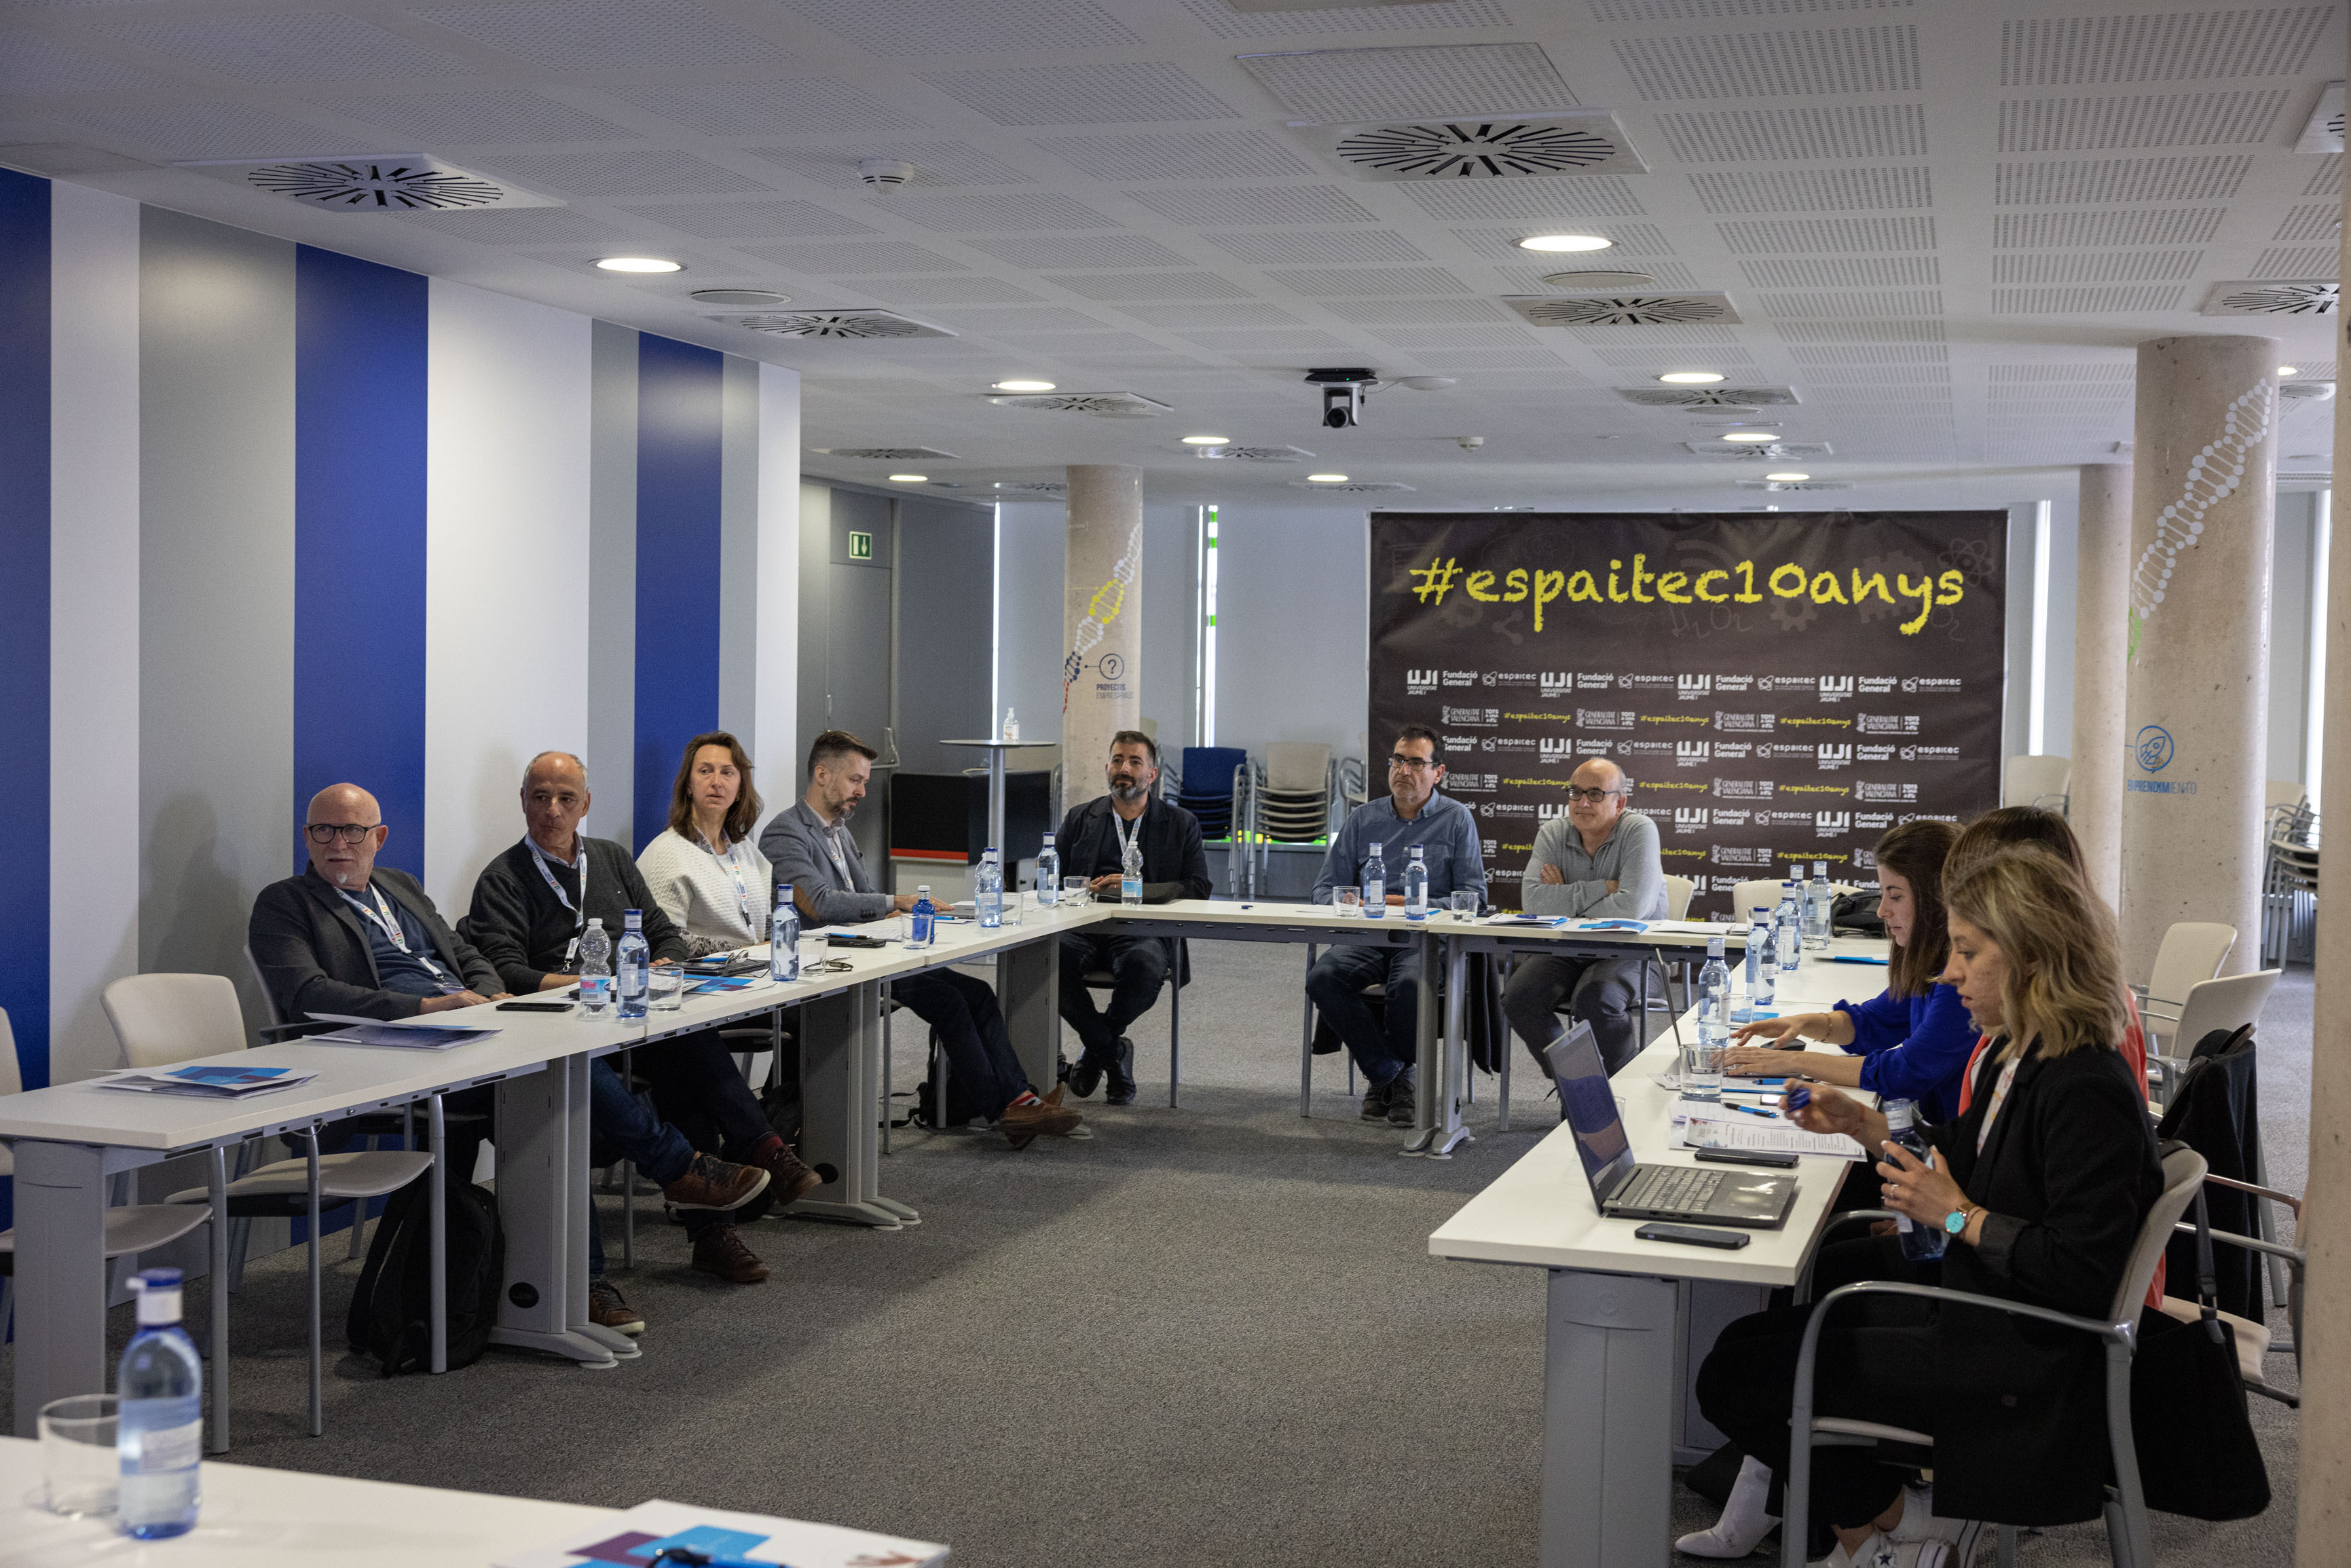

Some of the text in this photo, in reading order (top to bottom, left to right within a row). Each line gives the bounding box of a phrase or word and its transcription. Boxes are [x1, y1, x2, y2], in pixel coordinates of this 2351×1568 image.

[1409, 554, 1964, 635] #espaitec10anys
[1407, 670, 1438, 684] UJI
[1443, 671, 1478, 679] Fundació
[1540, 672, 1572, 687] UJI
[1577, 673, 1614, 681] Fundació
[1716, 675, 1753, 684] Fundació
[1678, 674, 1711, 690] UJI
[1819, 675, 1853, 691] UJI
[1859, 677, 1897, 685] Fundació
[1504, 713, 1571, 724] #espaitec10anys
[1640, 715, 1709, 726] #espaitec10anys
[1780, 717, 1851, 728] #espaitec10anys
[1540, 738, 1571, 753] UJI
[1576, 739, 1613, 747] Fundació
[1676, 741, 1709, 756] UJI
[1714, 742, 1752, 750] Fundació
[1818, 743, 1852, 759] UJI
[1857, 745, 1895, 753] Fundació
[1639, 782, 1708, 793] #espaitec10anys
[1779, 785, 1849, 796] #espaitec10anys
[1675, 808, 1708, 823] UJI
[1713, 809, 1750, 817] Fundació
[1855, 813, 1893, 821] Fundació
[1816, 811, 1850, 827] UJI
[1777, 852, 1848, 863] #espaitec10anys
